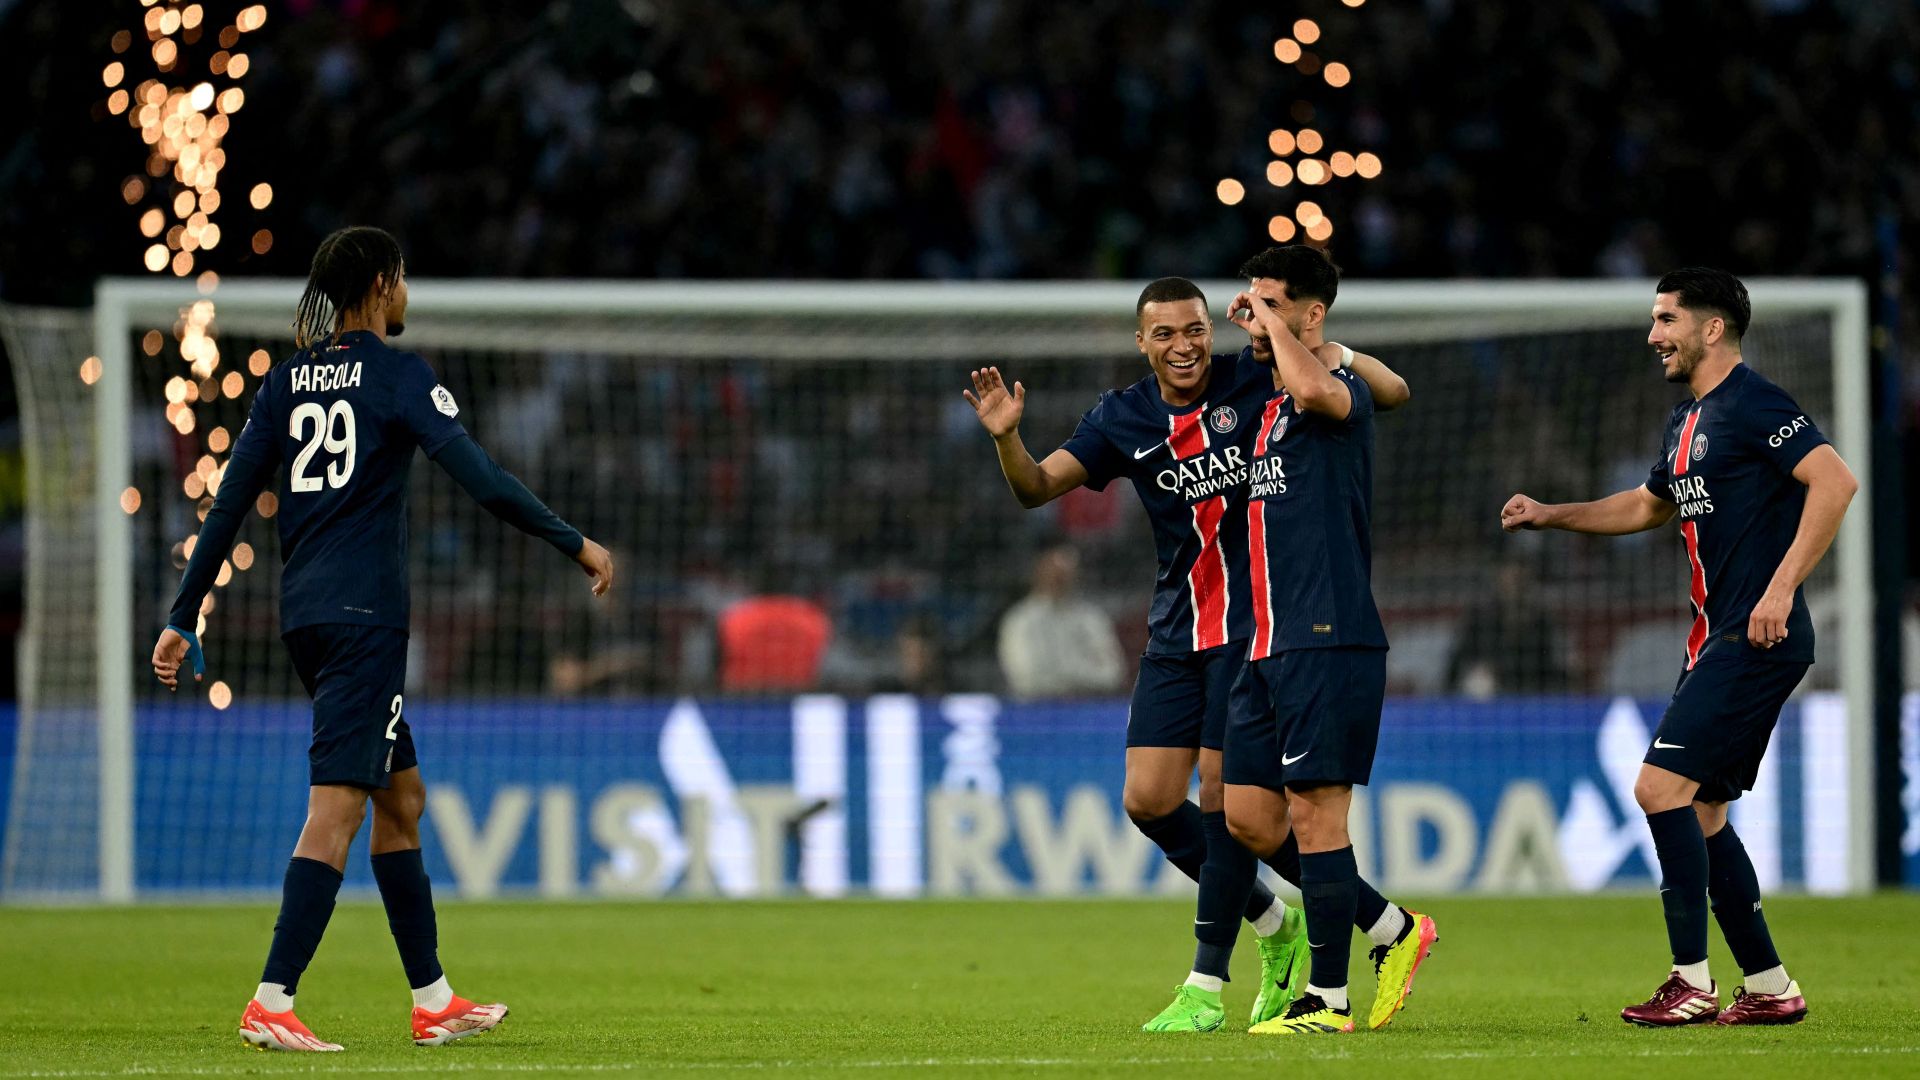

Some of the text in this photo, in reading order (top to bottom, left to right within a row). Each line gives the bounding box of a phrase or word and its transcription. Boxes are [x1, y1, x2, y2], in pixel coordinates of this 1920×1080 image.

[289, 399, 356, 493] 29
[1768, 415, 1810, 448] GOAT
[1156, 445, 1247, 495] QATAR
[1185, 467, 1248, 501] AIRWAYS
[1249, 456, 1286, 485] ATAR
[427, 783, 813, 894] VISIT
[928, 783, 1568, 894] RWDA
